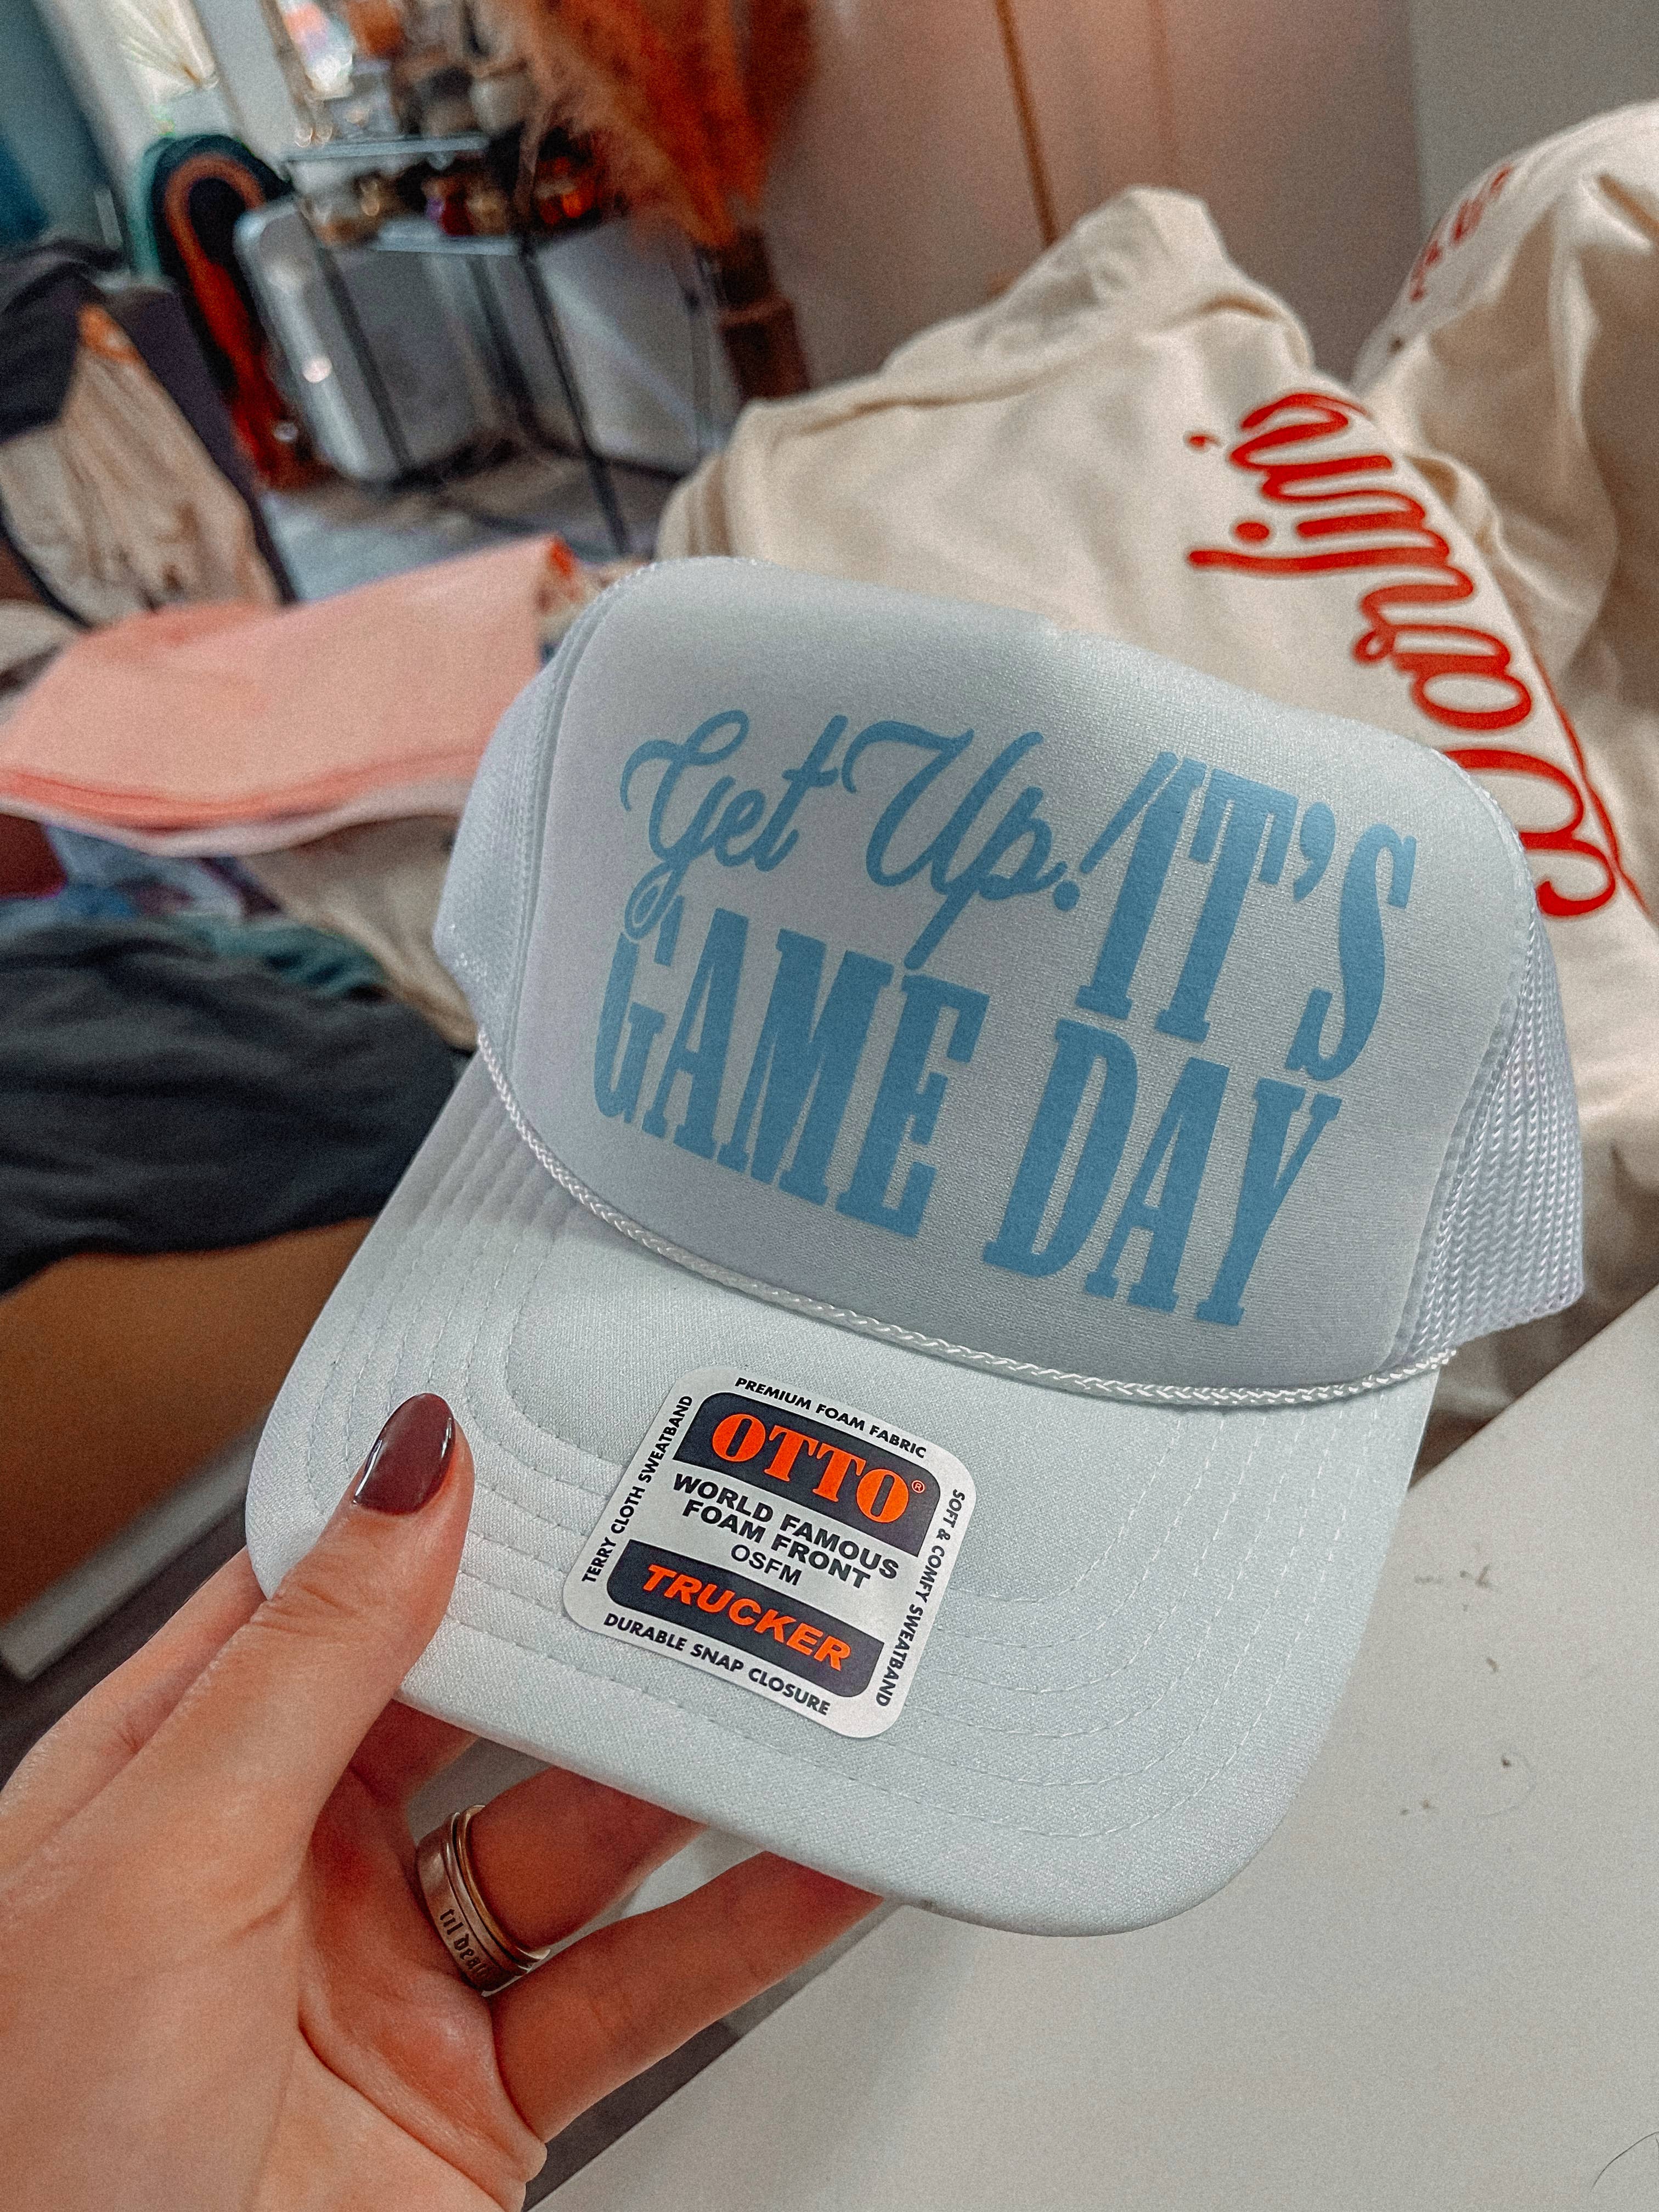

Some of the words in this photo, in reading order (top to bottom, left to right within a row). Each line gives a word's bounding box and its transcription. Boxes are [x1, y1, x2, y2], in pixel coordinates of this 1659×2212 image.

[620, 709, 848, 940] Get
[1074, 758, 1417, 1082] IT'S
[593, 895, 990, 1239] GAME
[982, 1019, 1342, 1328] DAY
[735, 1376, 812, 1410] PREMIUM
[815, 1403, 865, 1431] FOAM
[869, 1425, 927, 1459] FABRIC
[581, 1536, 617, 1583] TERRY
[611, 1486, 646, 1534] CLOTH
[637, 1395, 693, 1484] SWEATBAND
[673, 1472, 774, 1523] WORLD
[780, 1513, 900, 1580] FAMOUS
[936, 1528, 951, 1541] &
[943, 1488, 966, 1529] SOFT
[682, 1498, 767, 1544] FOAM
[770, 1533, 872, 1589] FRONT
[730, 1544, 803, 1587] OSFM
[915, 1545, 945, 1603] COMFY
[603, 1612, 689, 1652] DURABLE
[690, 1643, 744, 1673] SNAP
[748, 1667, 831, 1716] CLOSURE
[642, 1564, 852, 1672] TRUCKER
[876, 1603, 924, 1707] SWEATBAND
